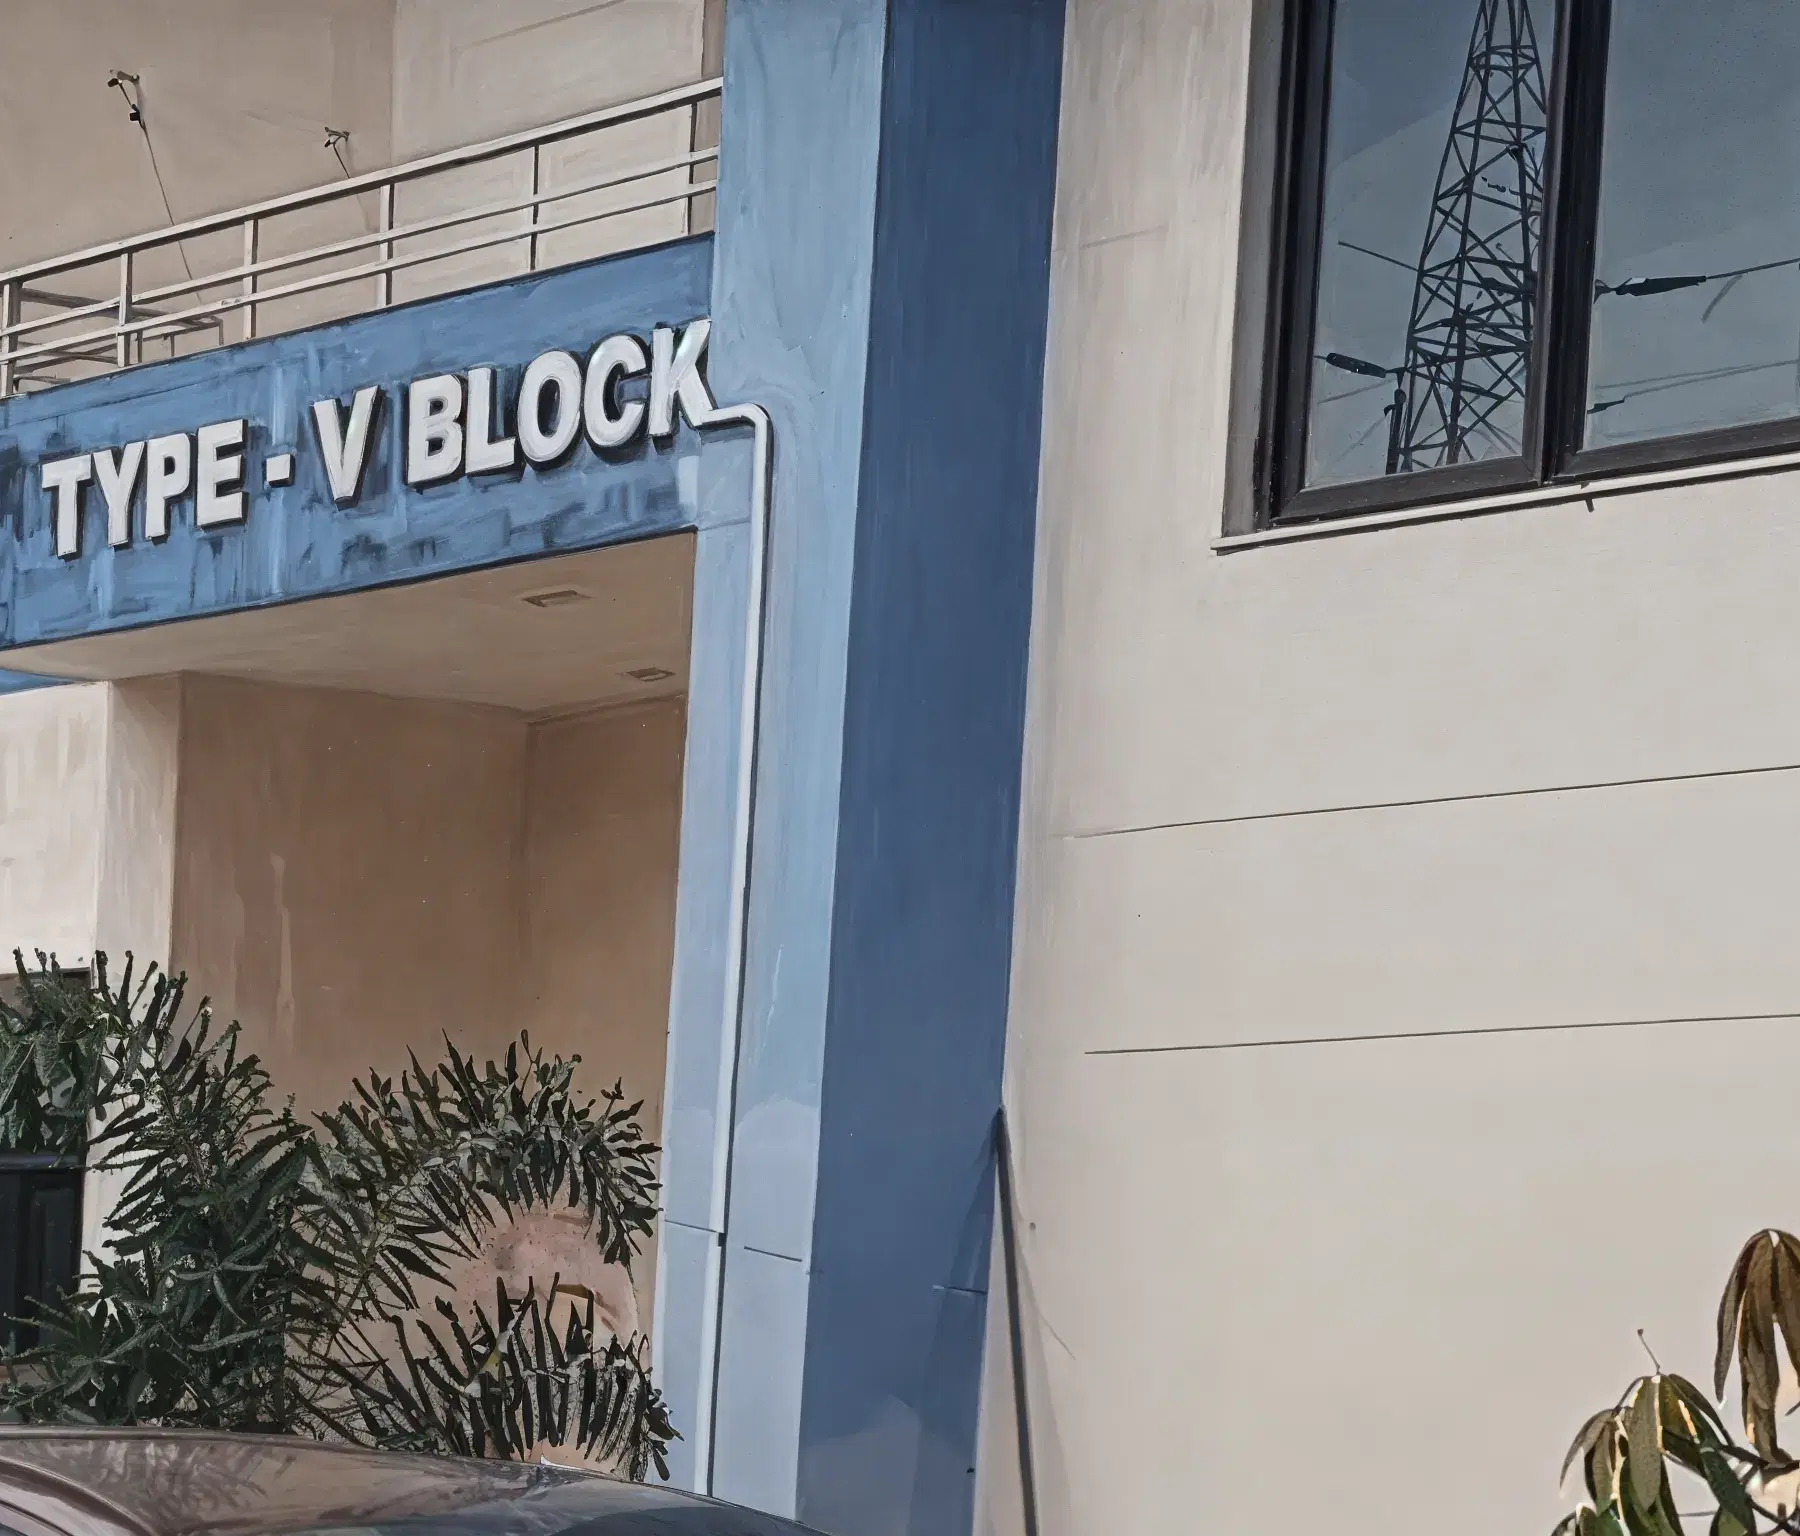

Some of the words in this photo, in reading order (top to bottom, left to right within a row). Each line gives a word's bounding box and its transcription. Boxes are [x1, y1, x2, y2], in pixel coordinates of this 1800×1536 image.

[41, 418, 247, 557] TYPE
[313, 385, 380, 501] V
[407, 318, 712, 485] BLOCK
